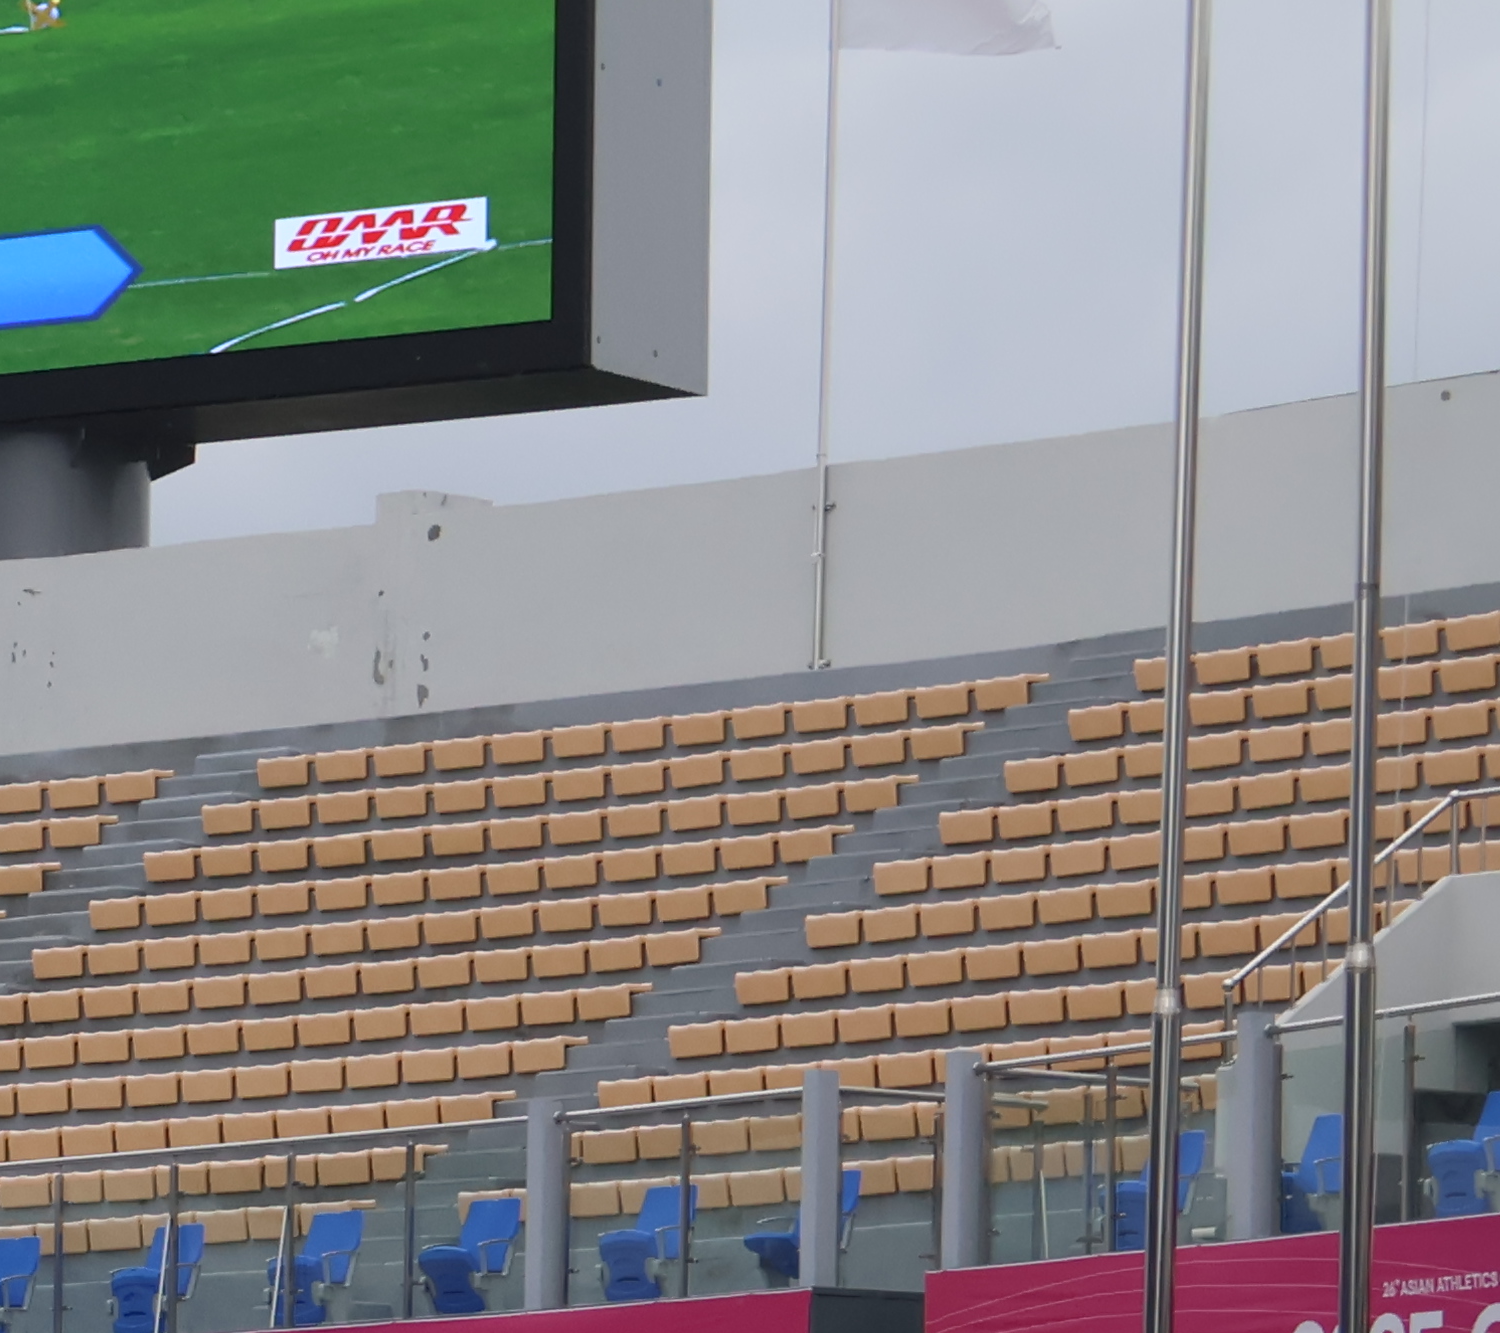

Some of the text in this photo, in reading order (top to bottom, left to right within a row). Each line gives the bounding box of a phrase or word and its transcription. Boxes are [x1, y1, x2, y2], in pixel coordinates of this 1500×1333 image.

[306, 239, 436, 262] OH MY RACE
[1400, 1278, 1434, 1296] ASIAN
[1436, 1271, 1499, 1293] ATHLETICS
